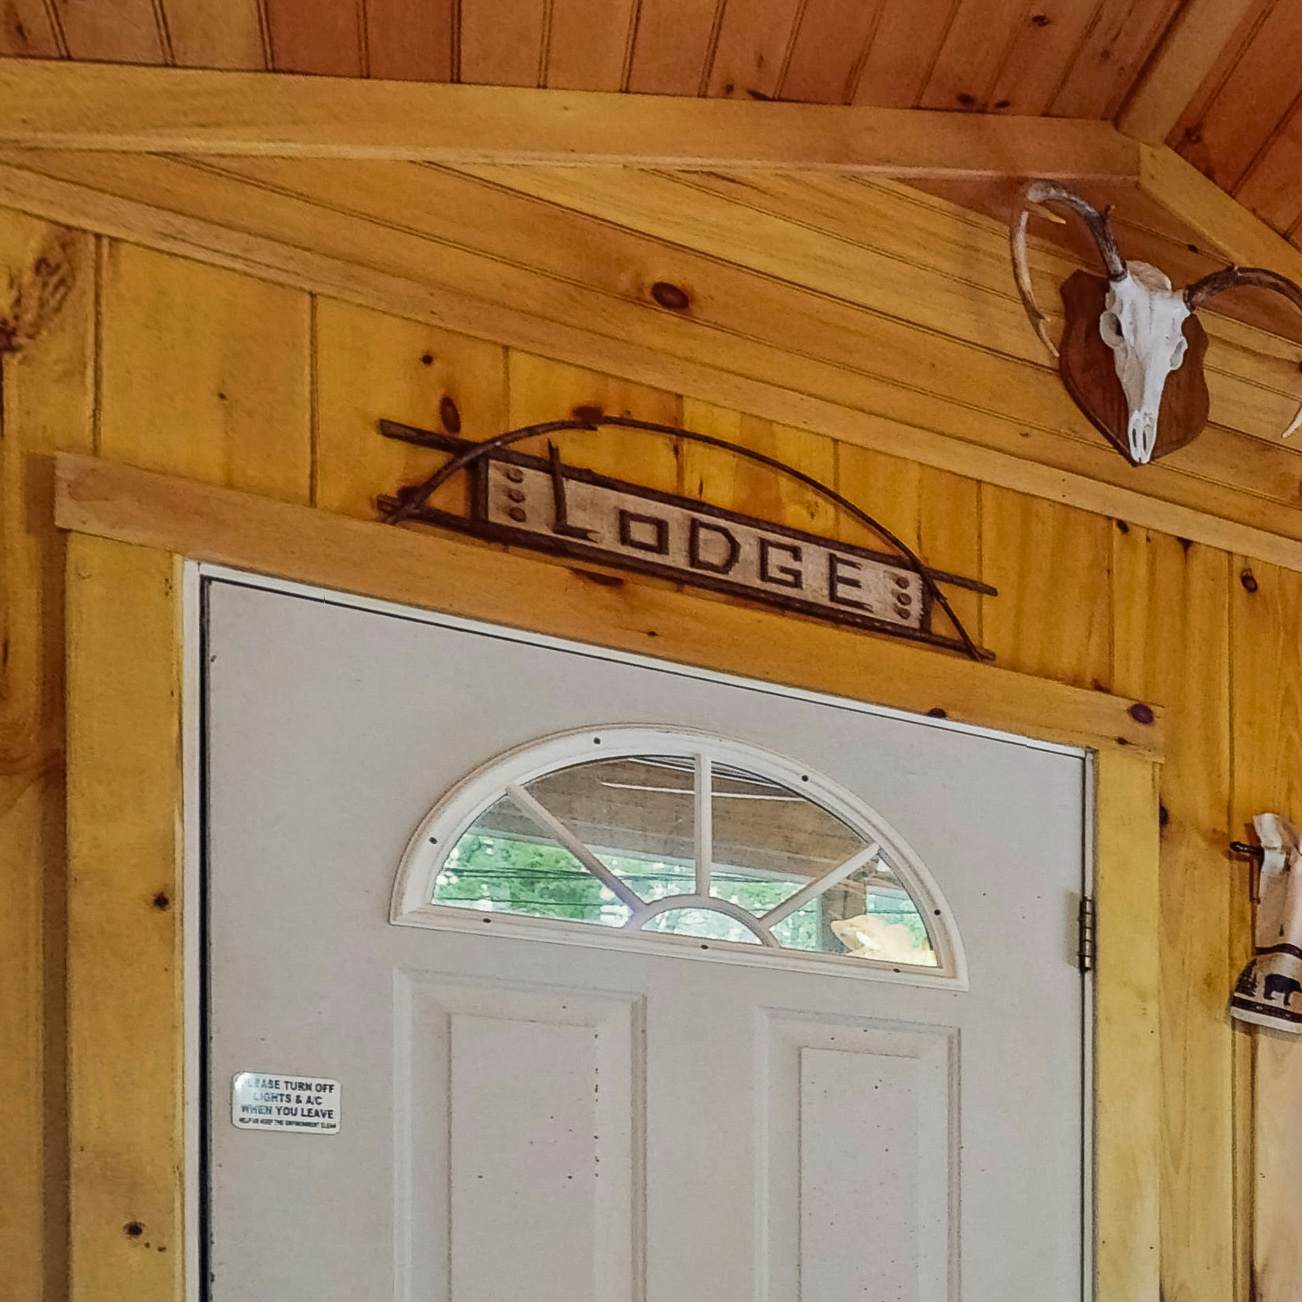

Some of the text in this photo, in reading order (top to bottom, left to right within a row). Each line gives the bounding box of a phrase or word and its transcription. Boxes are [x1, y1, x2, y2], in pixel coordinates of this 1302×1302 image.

[241, 1078, 335, 1093] LEASE TURN OFF
[253, 1092, 291, 1103] LIGHTS
[295, 1094, 302, 1104] &
[241, 1104, 334, 1119] WHEN YOU LEAVE
